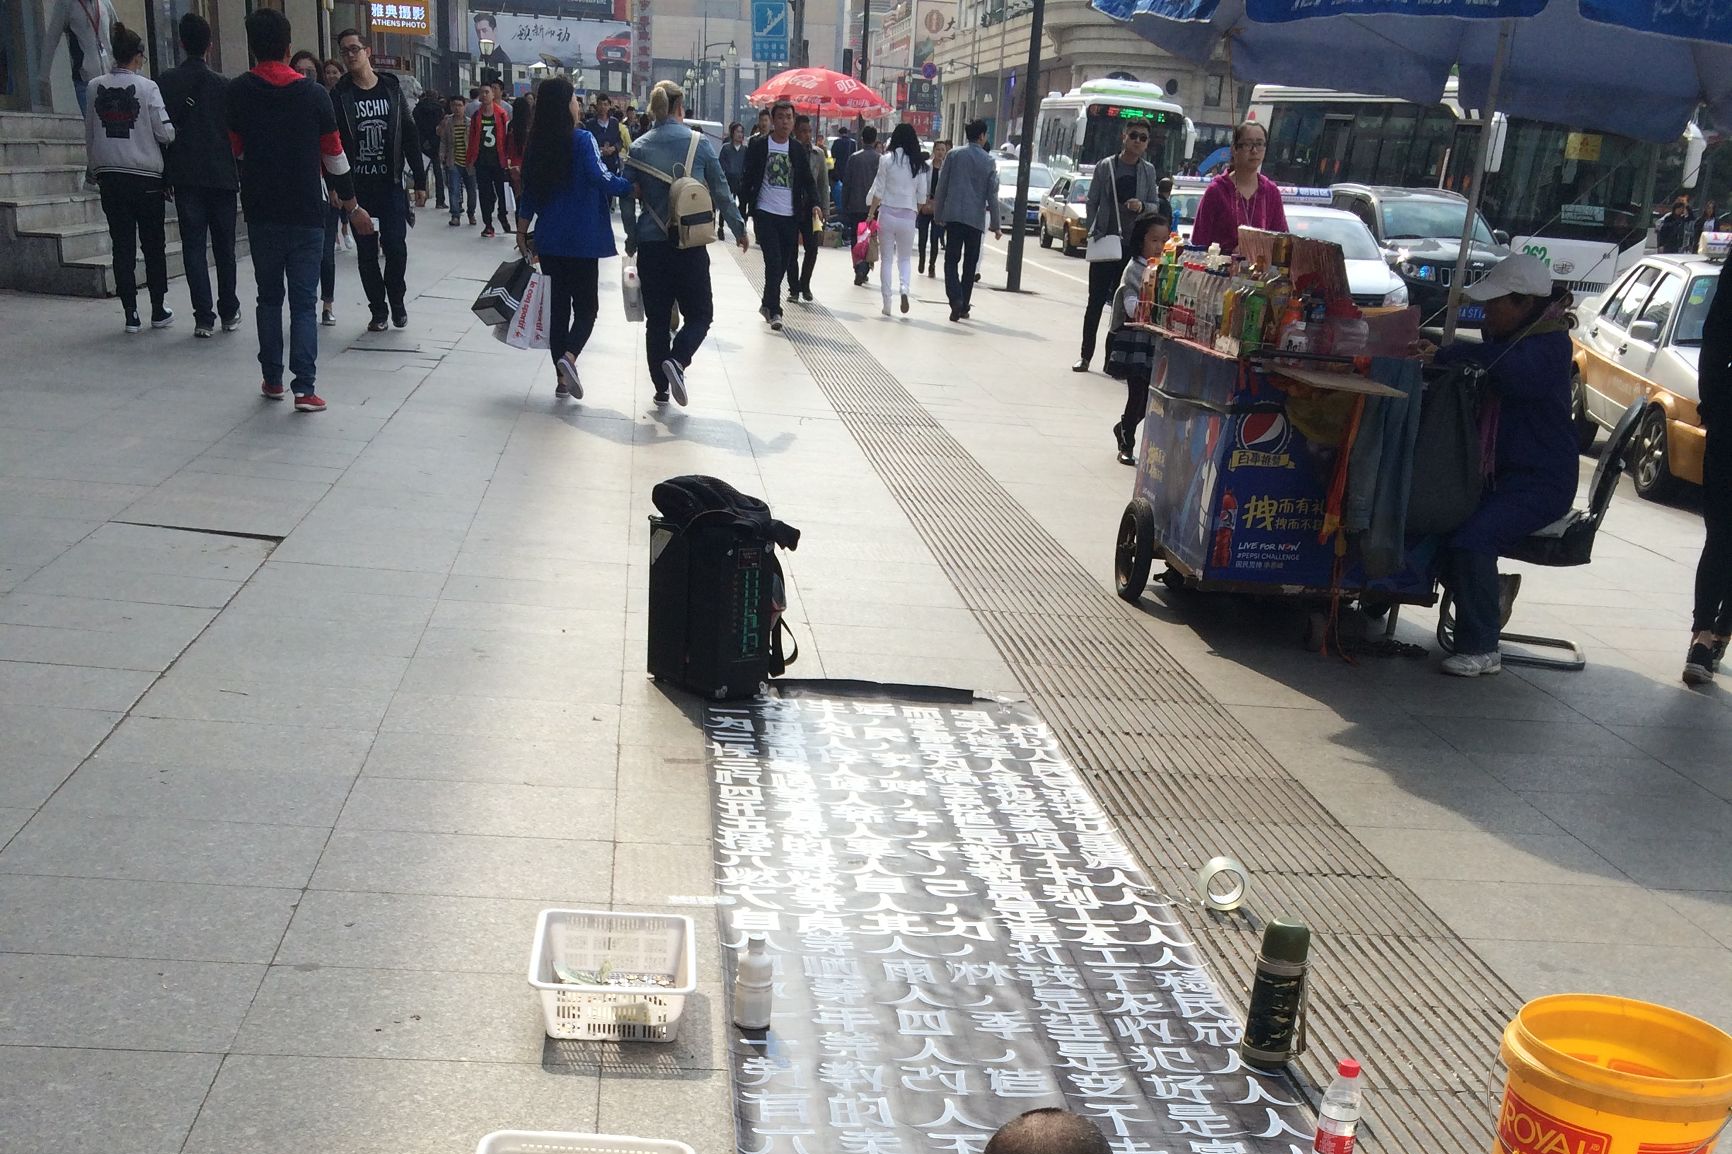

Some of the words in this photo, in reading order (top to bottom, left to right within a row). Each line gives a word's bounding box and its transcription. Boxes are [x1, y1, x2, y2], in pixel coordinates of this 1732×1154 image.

[372, 18, 400, 27] ATHENS
[401, 20, 427, 29] PHOTO
[482, 125, 496, 148] 3
[1238, 541, 1258, 550] LIVE
[1278, 541, 1301, 551] NOW
[1261, 553, 1300, 561] CHALLENGE
